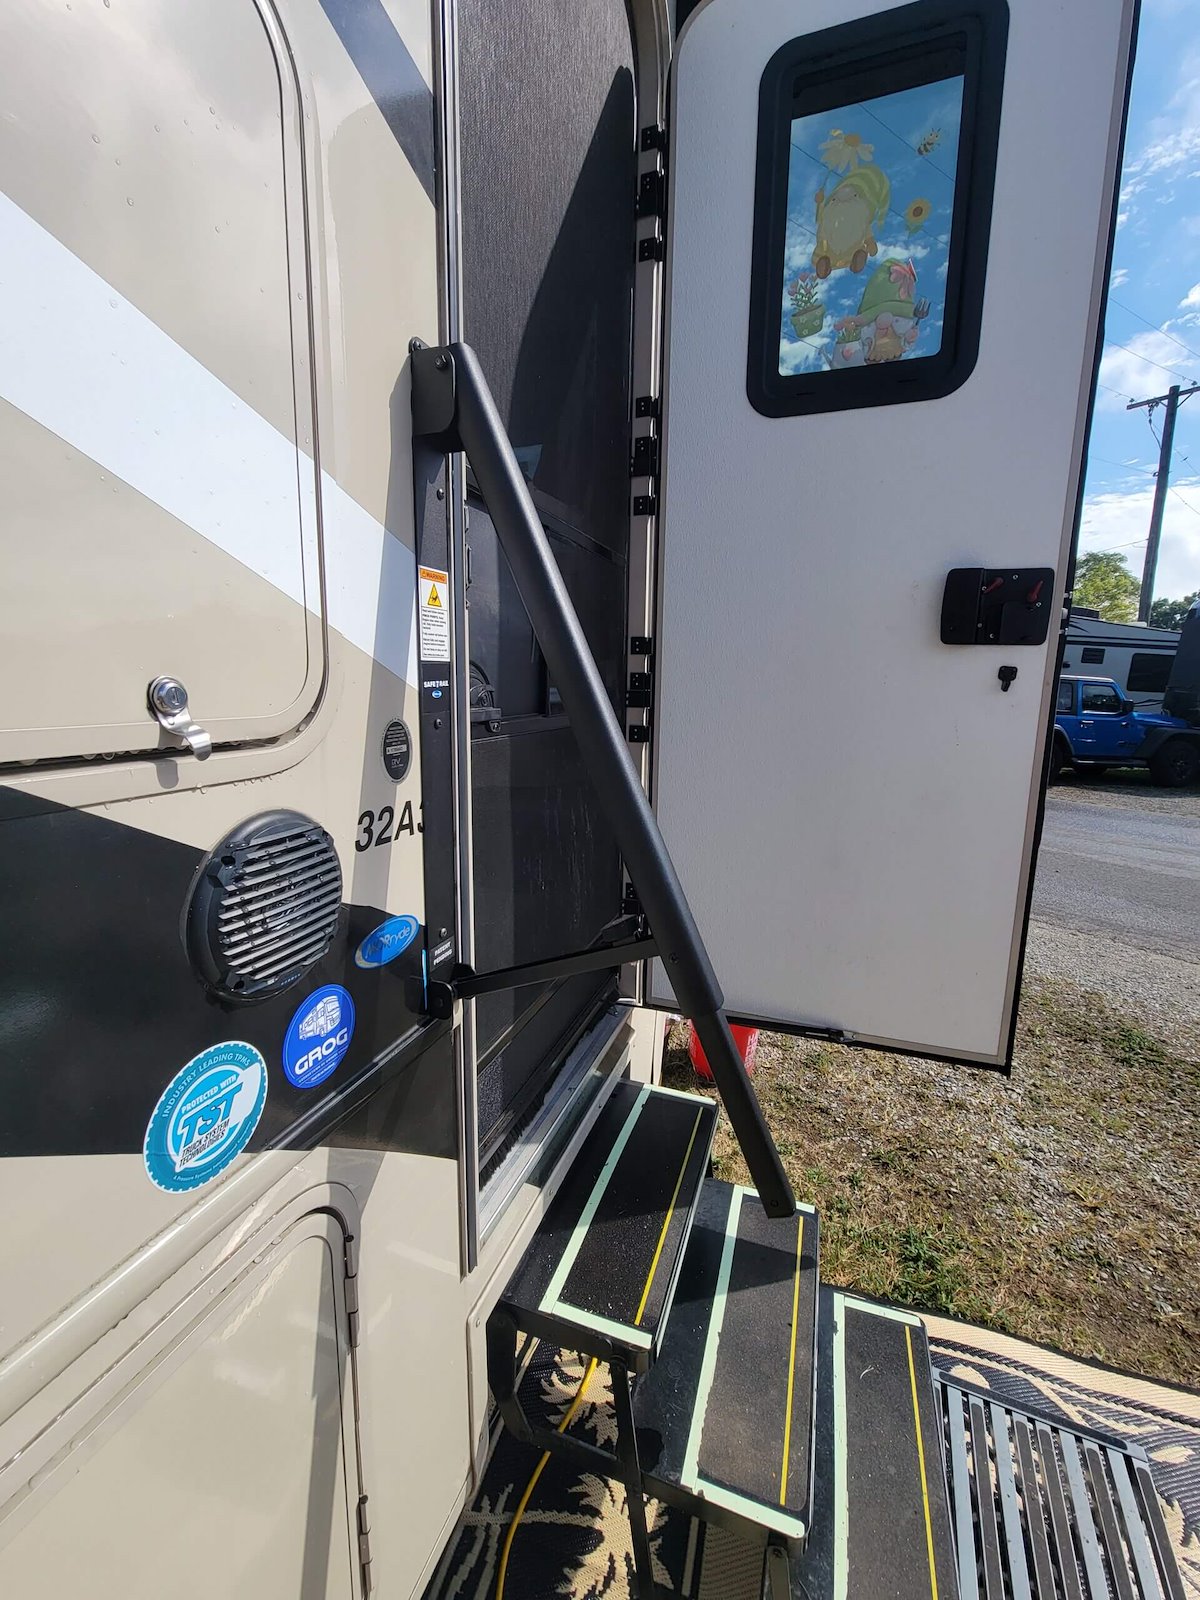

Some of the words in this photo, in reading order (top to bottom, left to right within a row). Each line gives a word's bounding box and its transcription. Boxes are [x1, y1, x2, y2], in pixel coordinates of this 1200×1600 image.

[294, 1027, 348, 1075] GROG
[162, 1070, 197, 1118] INDUSTRY
[198, 1052, 234, 1072] LEADING
[234, 1053, 251, 1067] TPMS
[181, 1085, 219, 1114] PROTECTED
[219, 1074, 238, 1090] WITH
[181, 1082, 243, 1148] TST
[182, 1136, 204, 1159] TRUCK
[203, 1119, 230, 1142] SYSTEM
